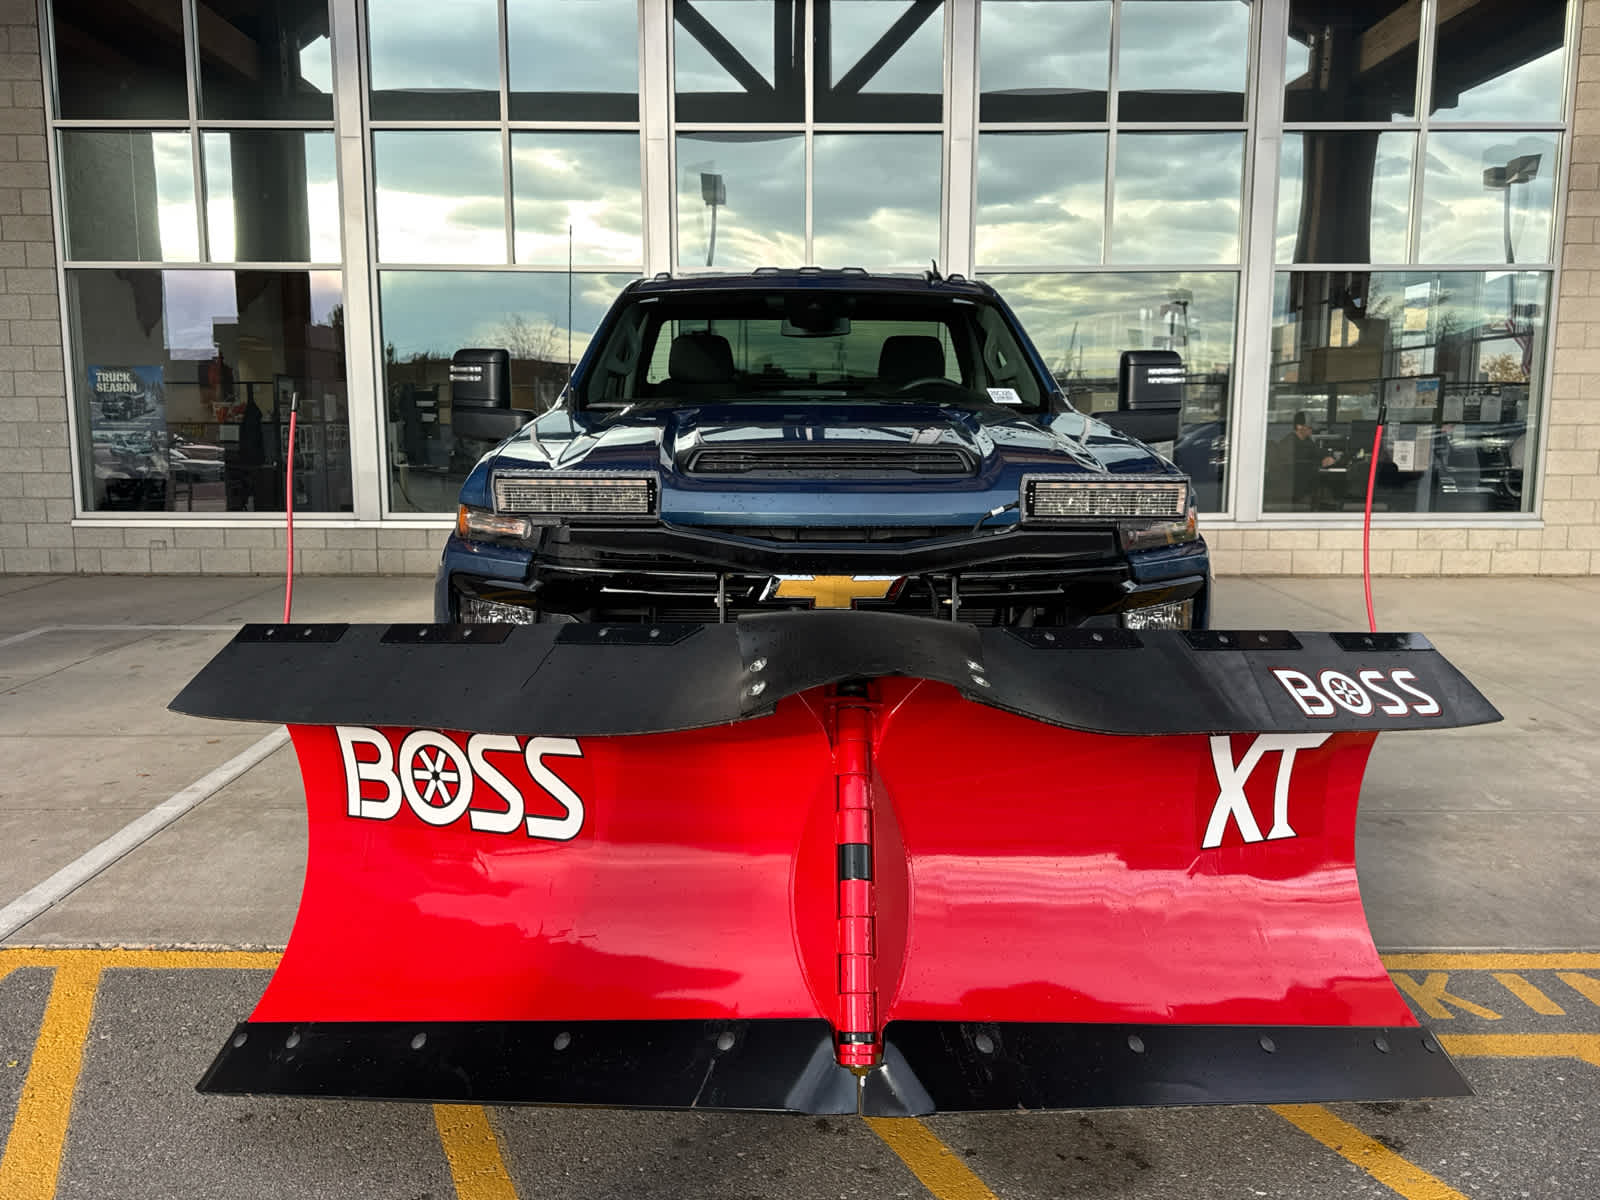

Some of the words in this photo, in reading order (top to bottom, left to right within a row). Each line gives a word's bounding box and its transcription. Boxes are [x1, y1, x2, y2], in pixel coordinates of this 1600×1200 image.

[96, 372, 131, 382] TRUCK
[96, 382, 137, 393] SEASON
[1269, 668, 1442, 718] BOSS
[335, 725, 584, 842] BOSS
[1201, 732, 1334, 849] XT
